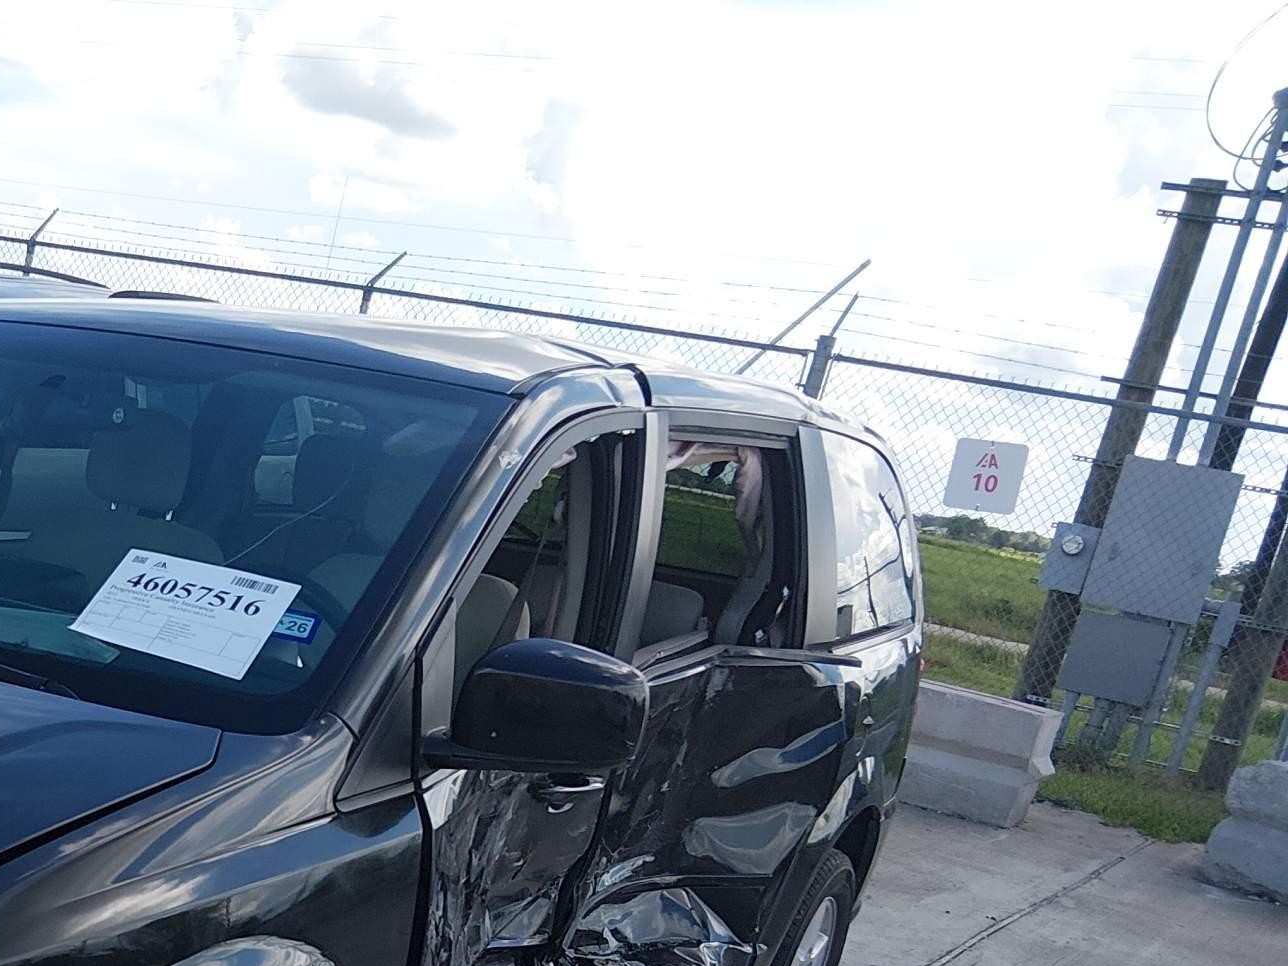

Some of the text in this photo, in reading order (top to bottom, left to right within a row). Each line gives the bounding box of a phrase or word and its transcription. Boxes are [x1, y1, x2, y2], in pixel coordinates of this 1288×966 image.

[972, 473, 999, 493] 10
[126, 572, 267, 617] 46057516
[285, 620, 309, 634] 26
